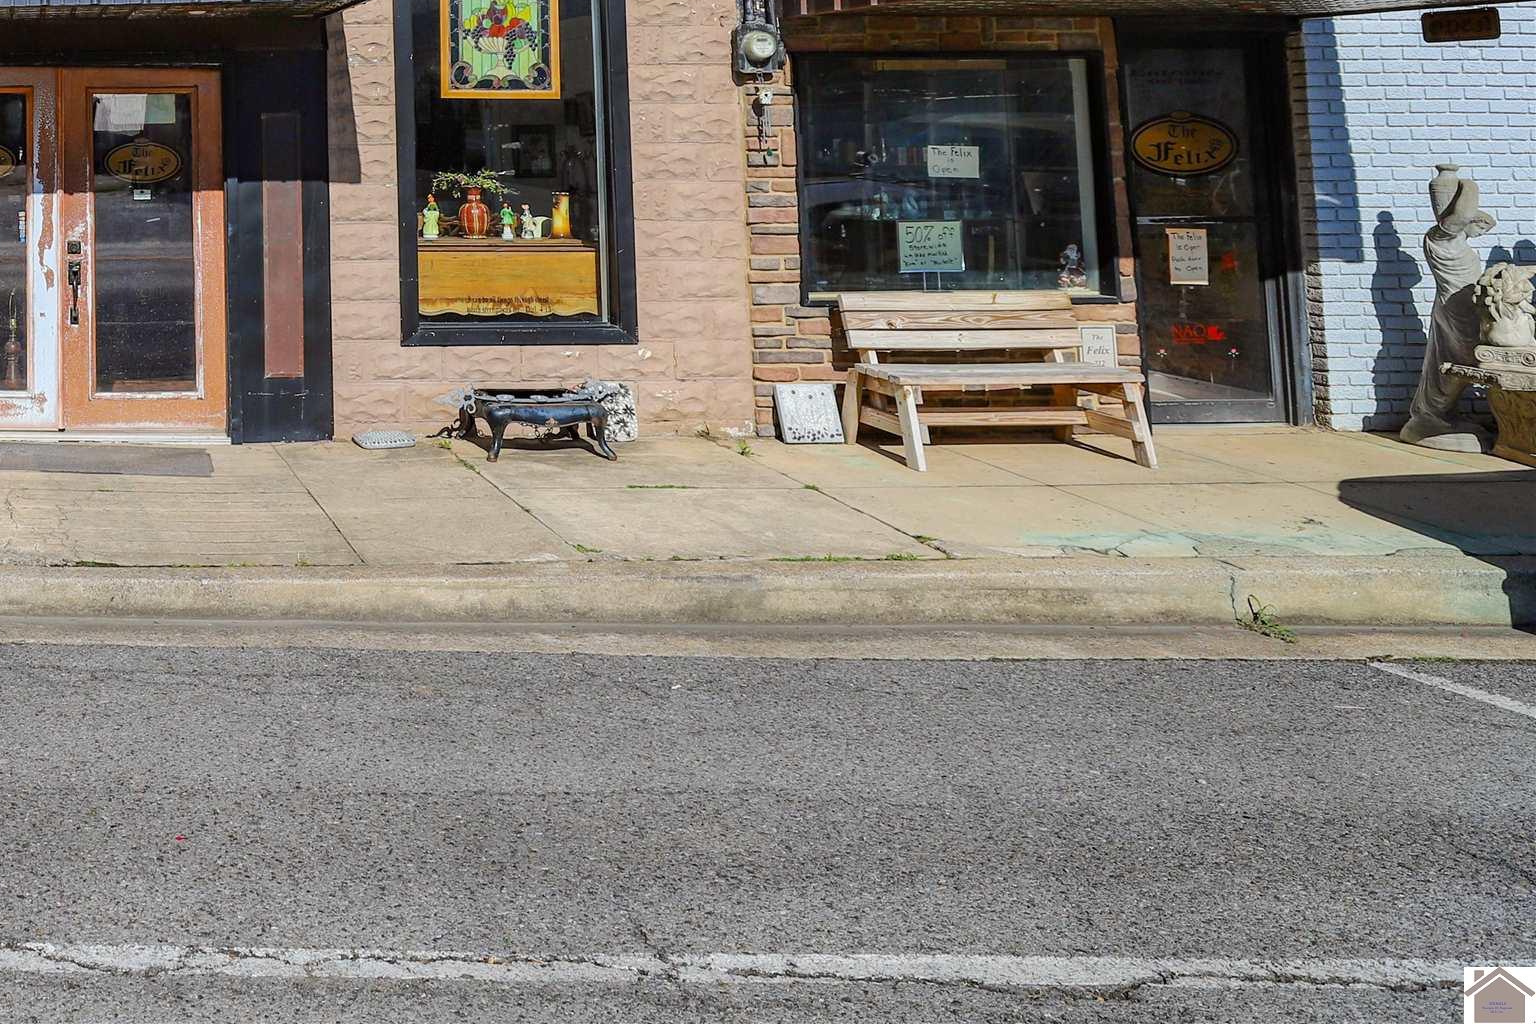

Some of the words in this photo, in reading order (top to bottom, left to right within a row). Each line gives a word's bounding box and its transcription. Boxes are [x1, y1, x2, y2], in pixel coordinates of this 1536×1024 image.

[1168, 125, 1197, 138] The
[930, 147, 949, 157] The
[1147, 142, 1217, 165] Felix
[115, 159, 166, 176] Felix
[905, 225, 934, 244] 50%
[1086, 345, 1110, 355] Felix
